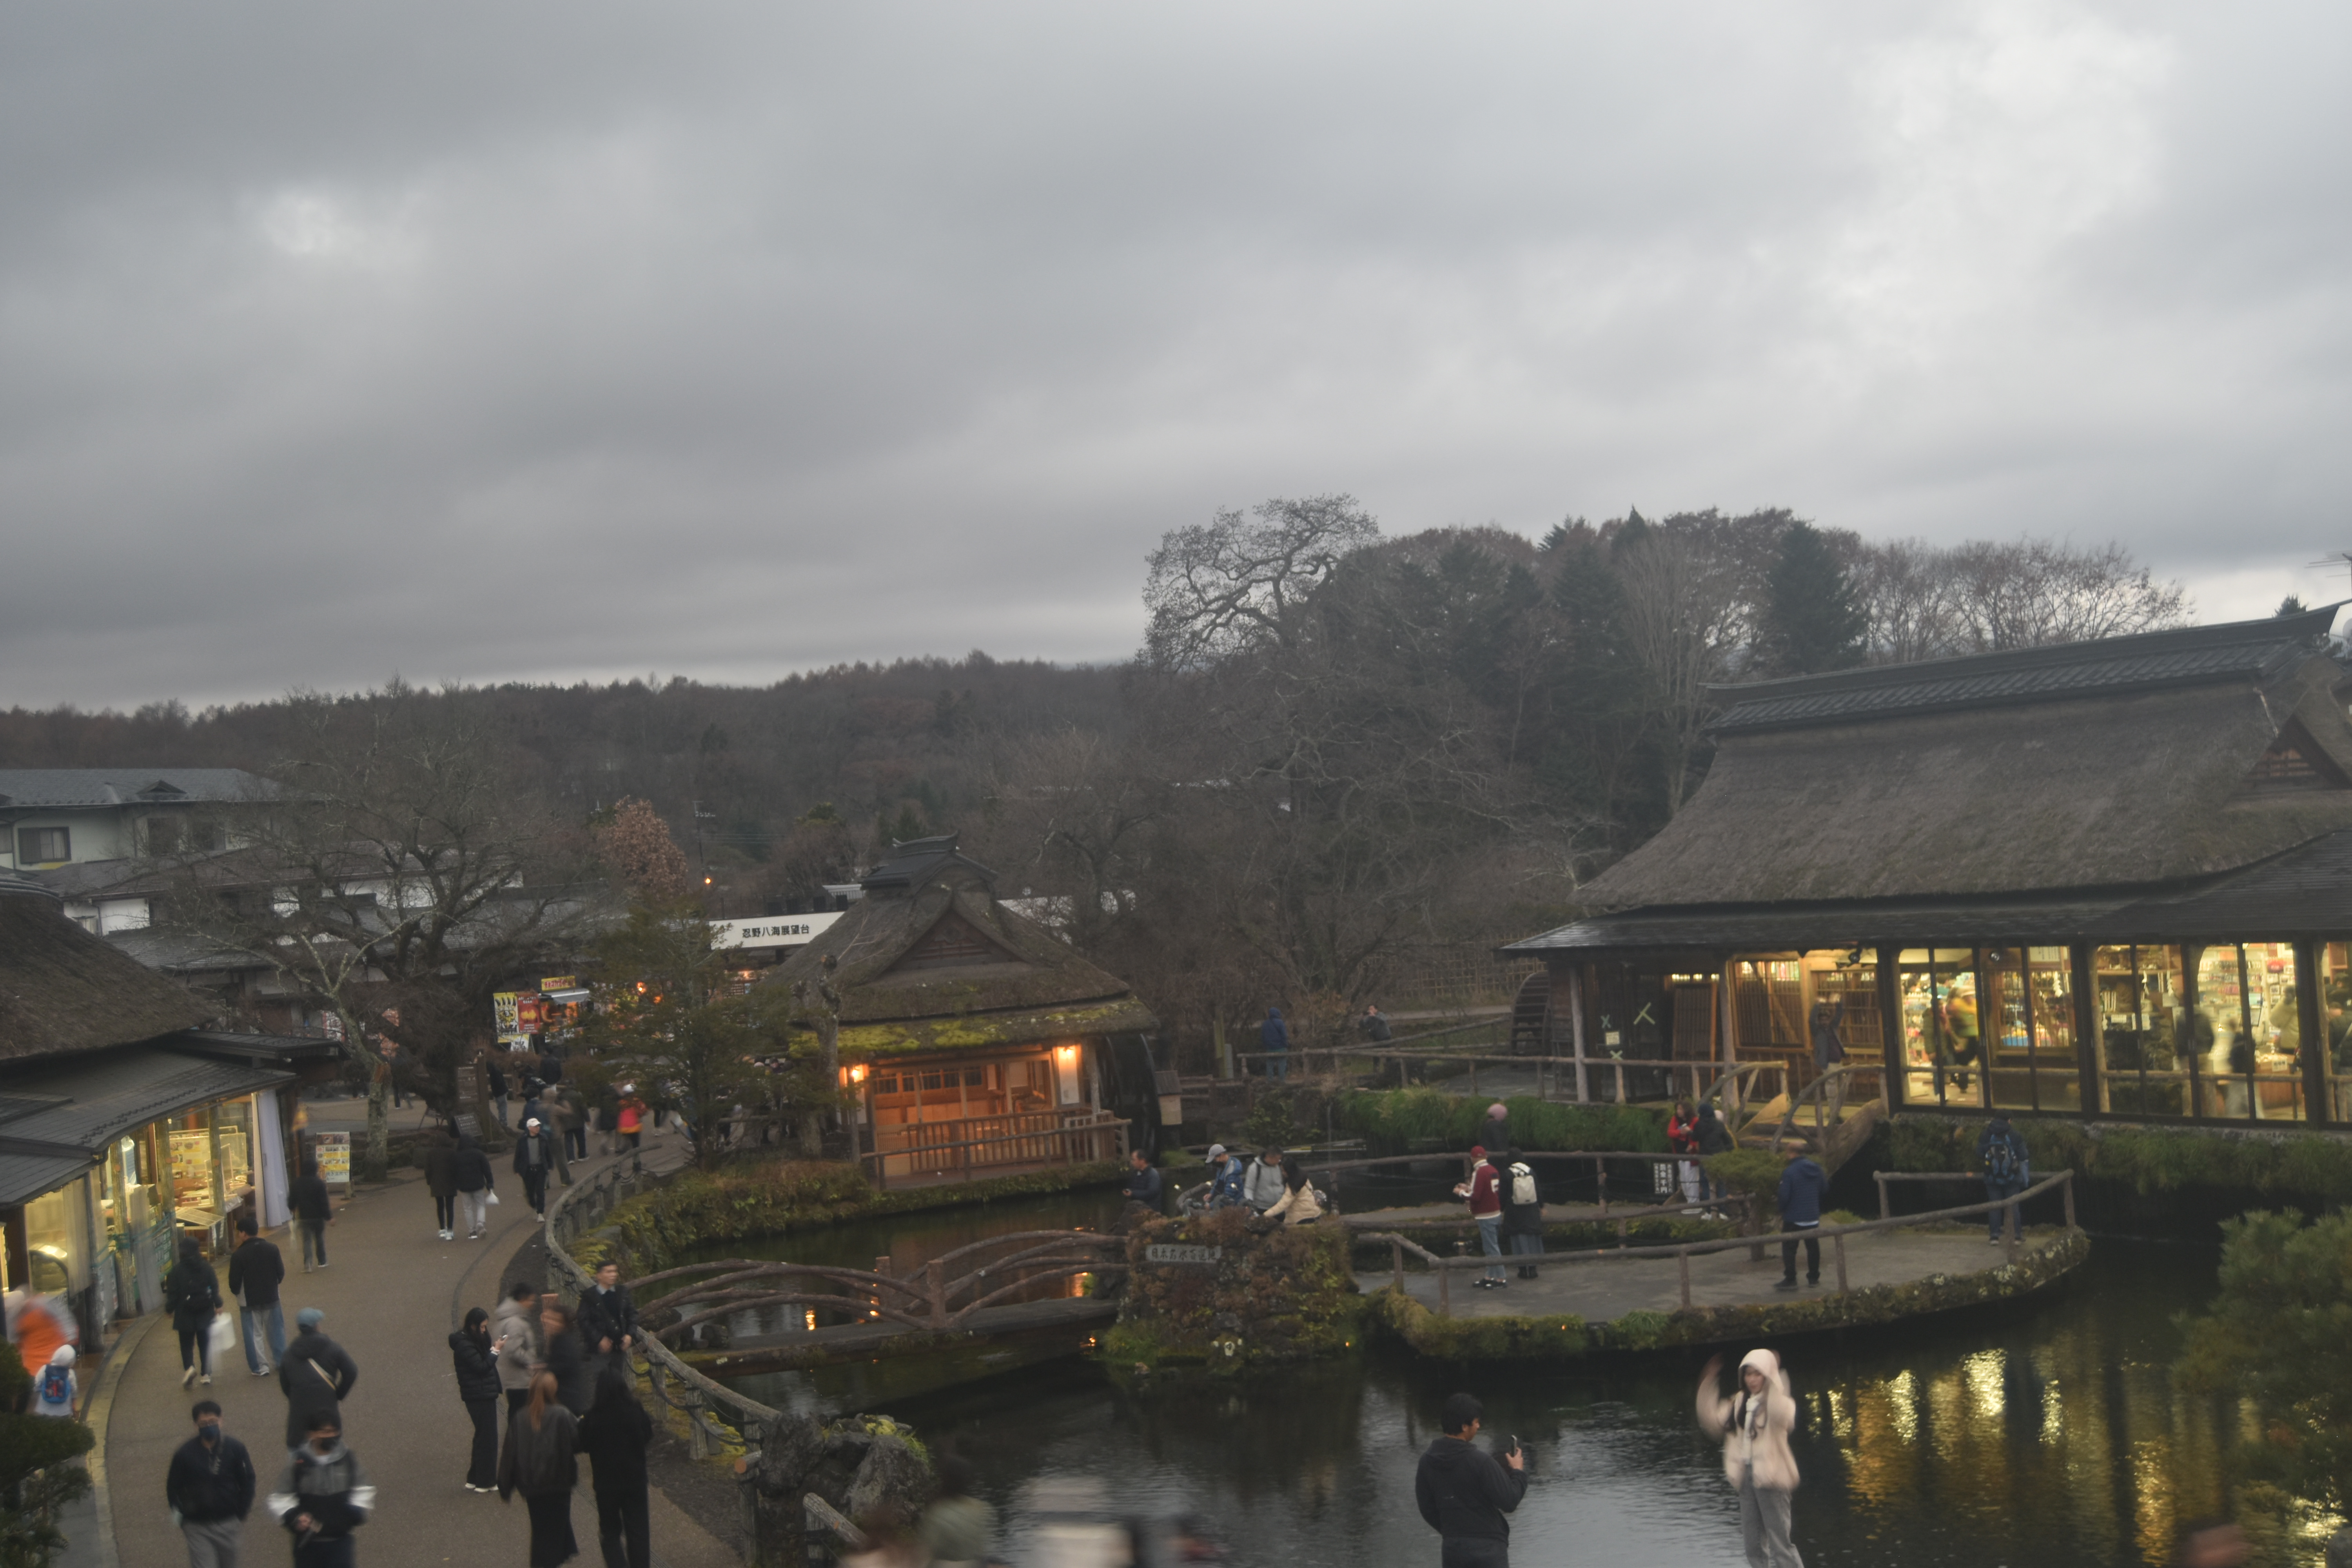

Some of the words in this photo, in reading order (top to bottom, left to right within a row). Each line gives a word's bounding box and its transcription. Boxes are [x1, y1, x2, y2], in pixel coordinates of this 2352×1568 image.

[742, 924, 809, 938] 忍野八海展望台
